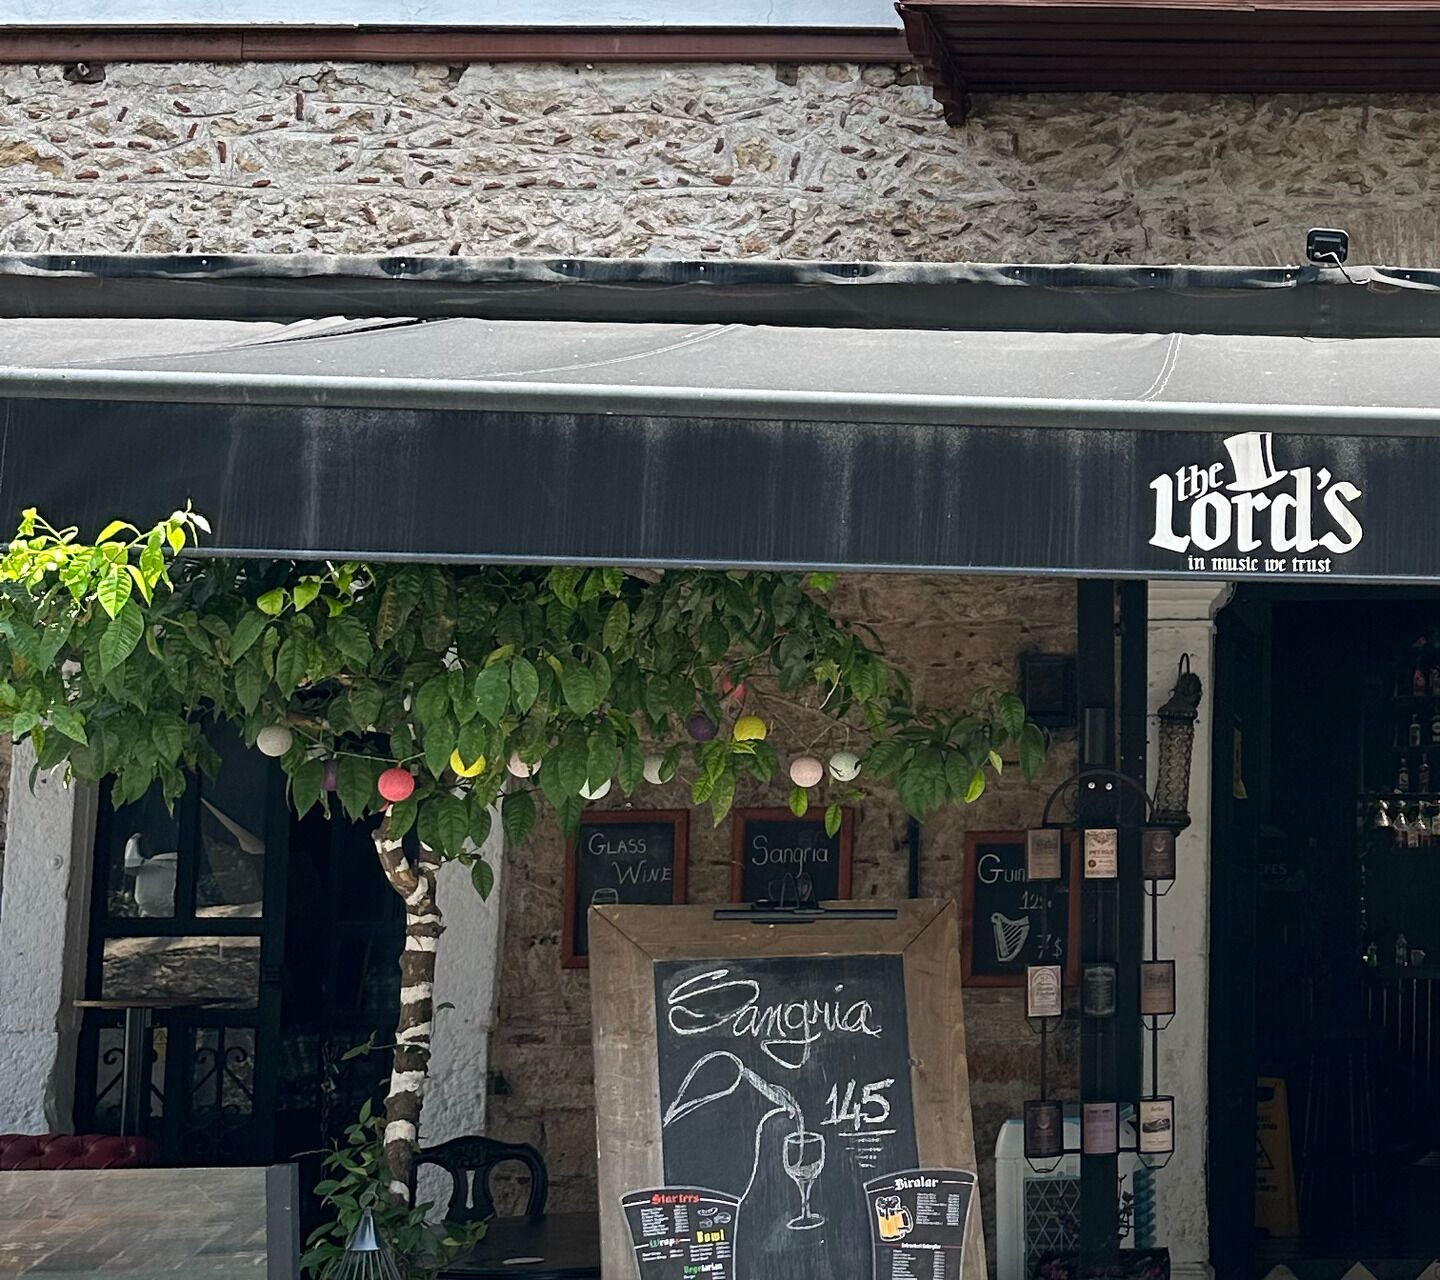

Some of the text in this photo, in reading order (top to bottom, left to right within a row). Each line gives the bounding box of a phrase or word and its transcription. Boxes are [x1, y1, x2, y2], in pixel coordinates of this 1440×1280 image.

[1175, 462, 1224, 501] the
[1188, 555, 1331, 572] in music we trust
[751, 834, 829, 879] Sangria
[668, 969, 882, 1069] Sangria
[820, 1078, 895, 1131] 145
[894, 1176, 939, 1191] Biralar
[650, 1191, 701, 1205] Starters
[696, 1228, 725, 1243] Bowl
